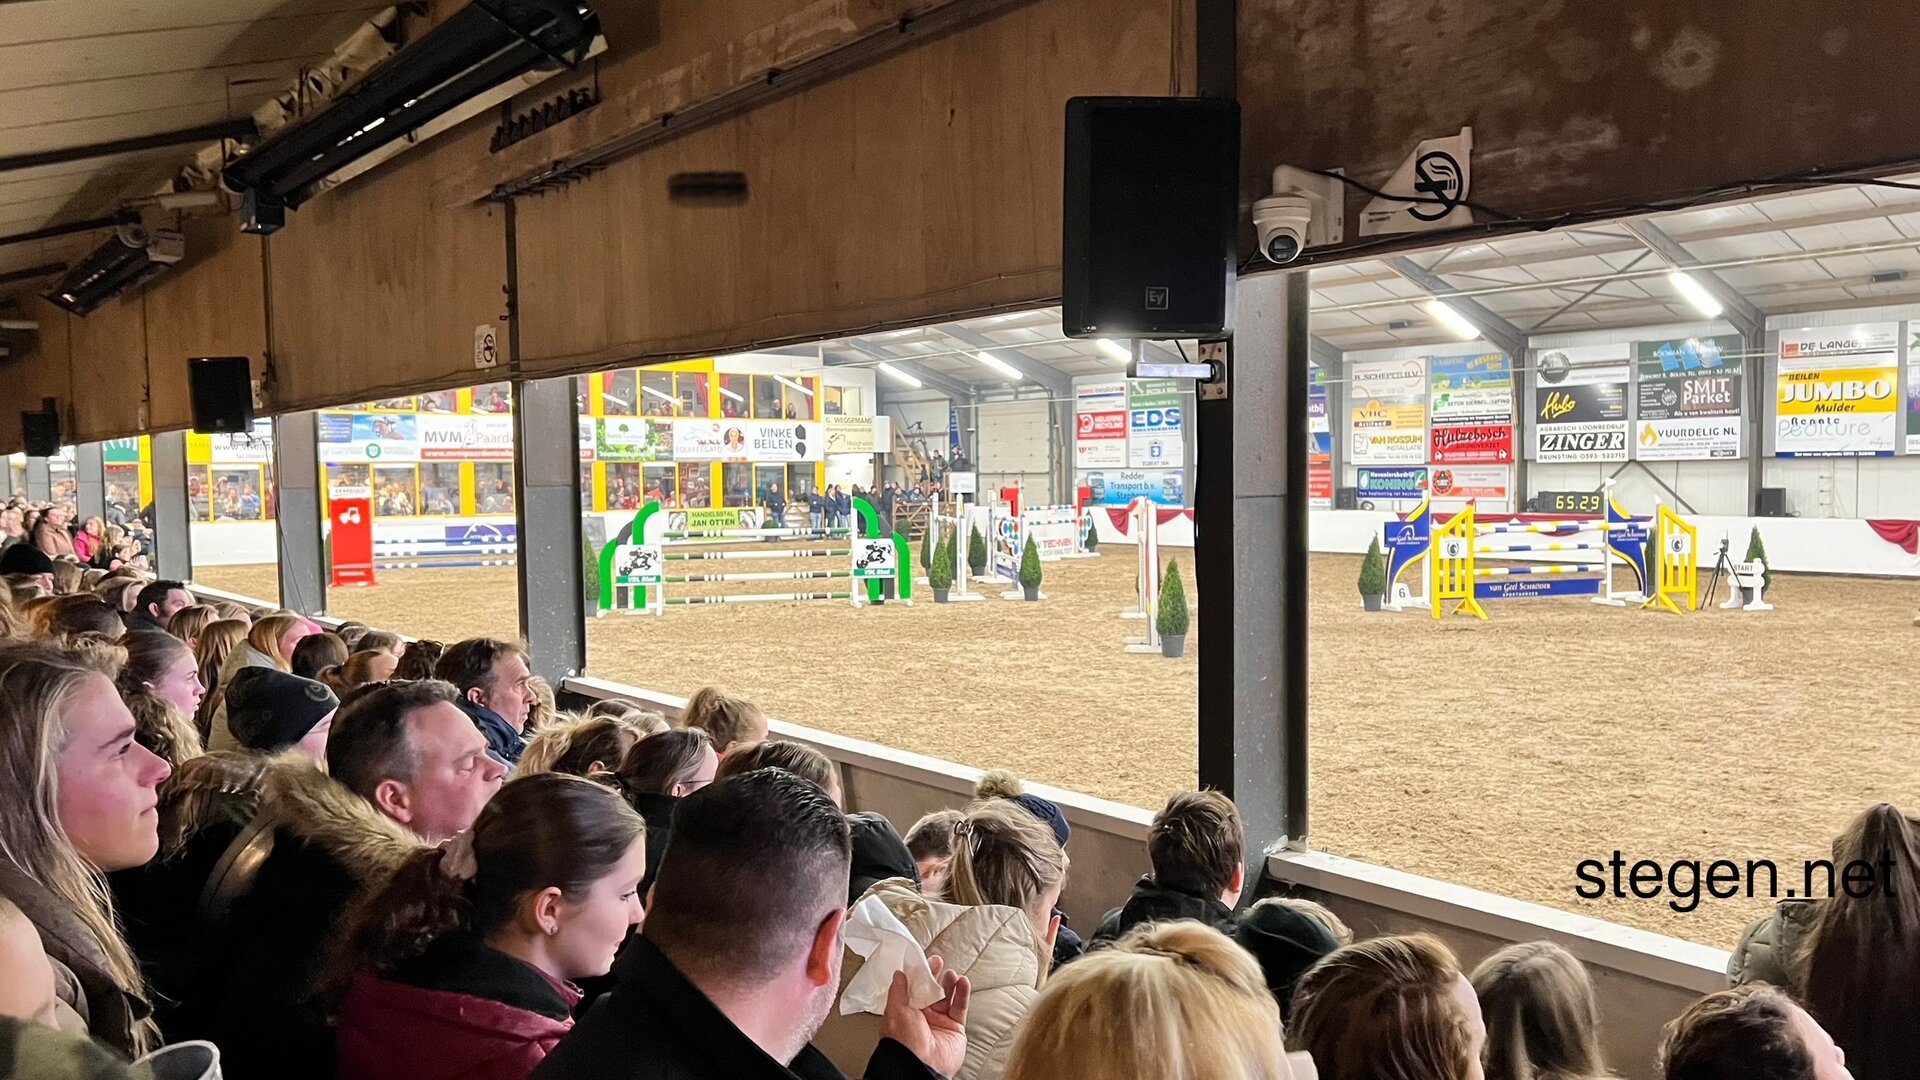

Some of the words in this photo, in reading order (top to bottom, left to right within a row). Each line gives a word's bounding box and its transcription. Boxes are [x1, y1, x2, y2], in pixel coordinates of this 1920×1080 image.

[1800, 342, 1816, 350] DE
[1684, 378, 1730, 394] SMIT
[1781, 378, 1892, 403] JUMBO
[1684, 390, 1730, 404] Parket
[1541, 392, 1576, 420] Hubo
[1814, 403, 1856, 412] Mulder
[1131, 408, 1182, 428] EDS
[424, 431, 462, 443] MVM
[760, 428, 792, 438] VINKE
[754, 439, 793, 450] BEILEN
[1370, 436, 1386, 444] VAN
[1387, 435, 1422, 444] ROSSUM
[1541, 432, 1624, 450] ZINGER
[1110, 482, 1142, 491] Transport
[1370, 478, 1414, 490] KONING
[1556, 496, 1600, 510] 65.29
[692, 510, 734, 518] HANDELSSTAL
[691, 519, 708, 527] JAN
[709, 518, 736, 527] OTTEN
[1398, 588, 1406, 598] 6
